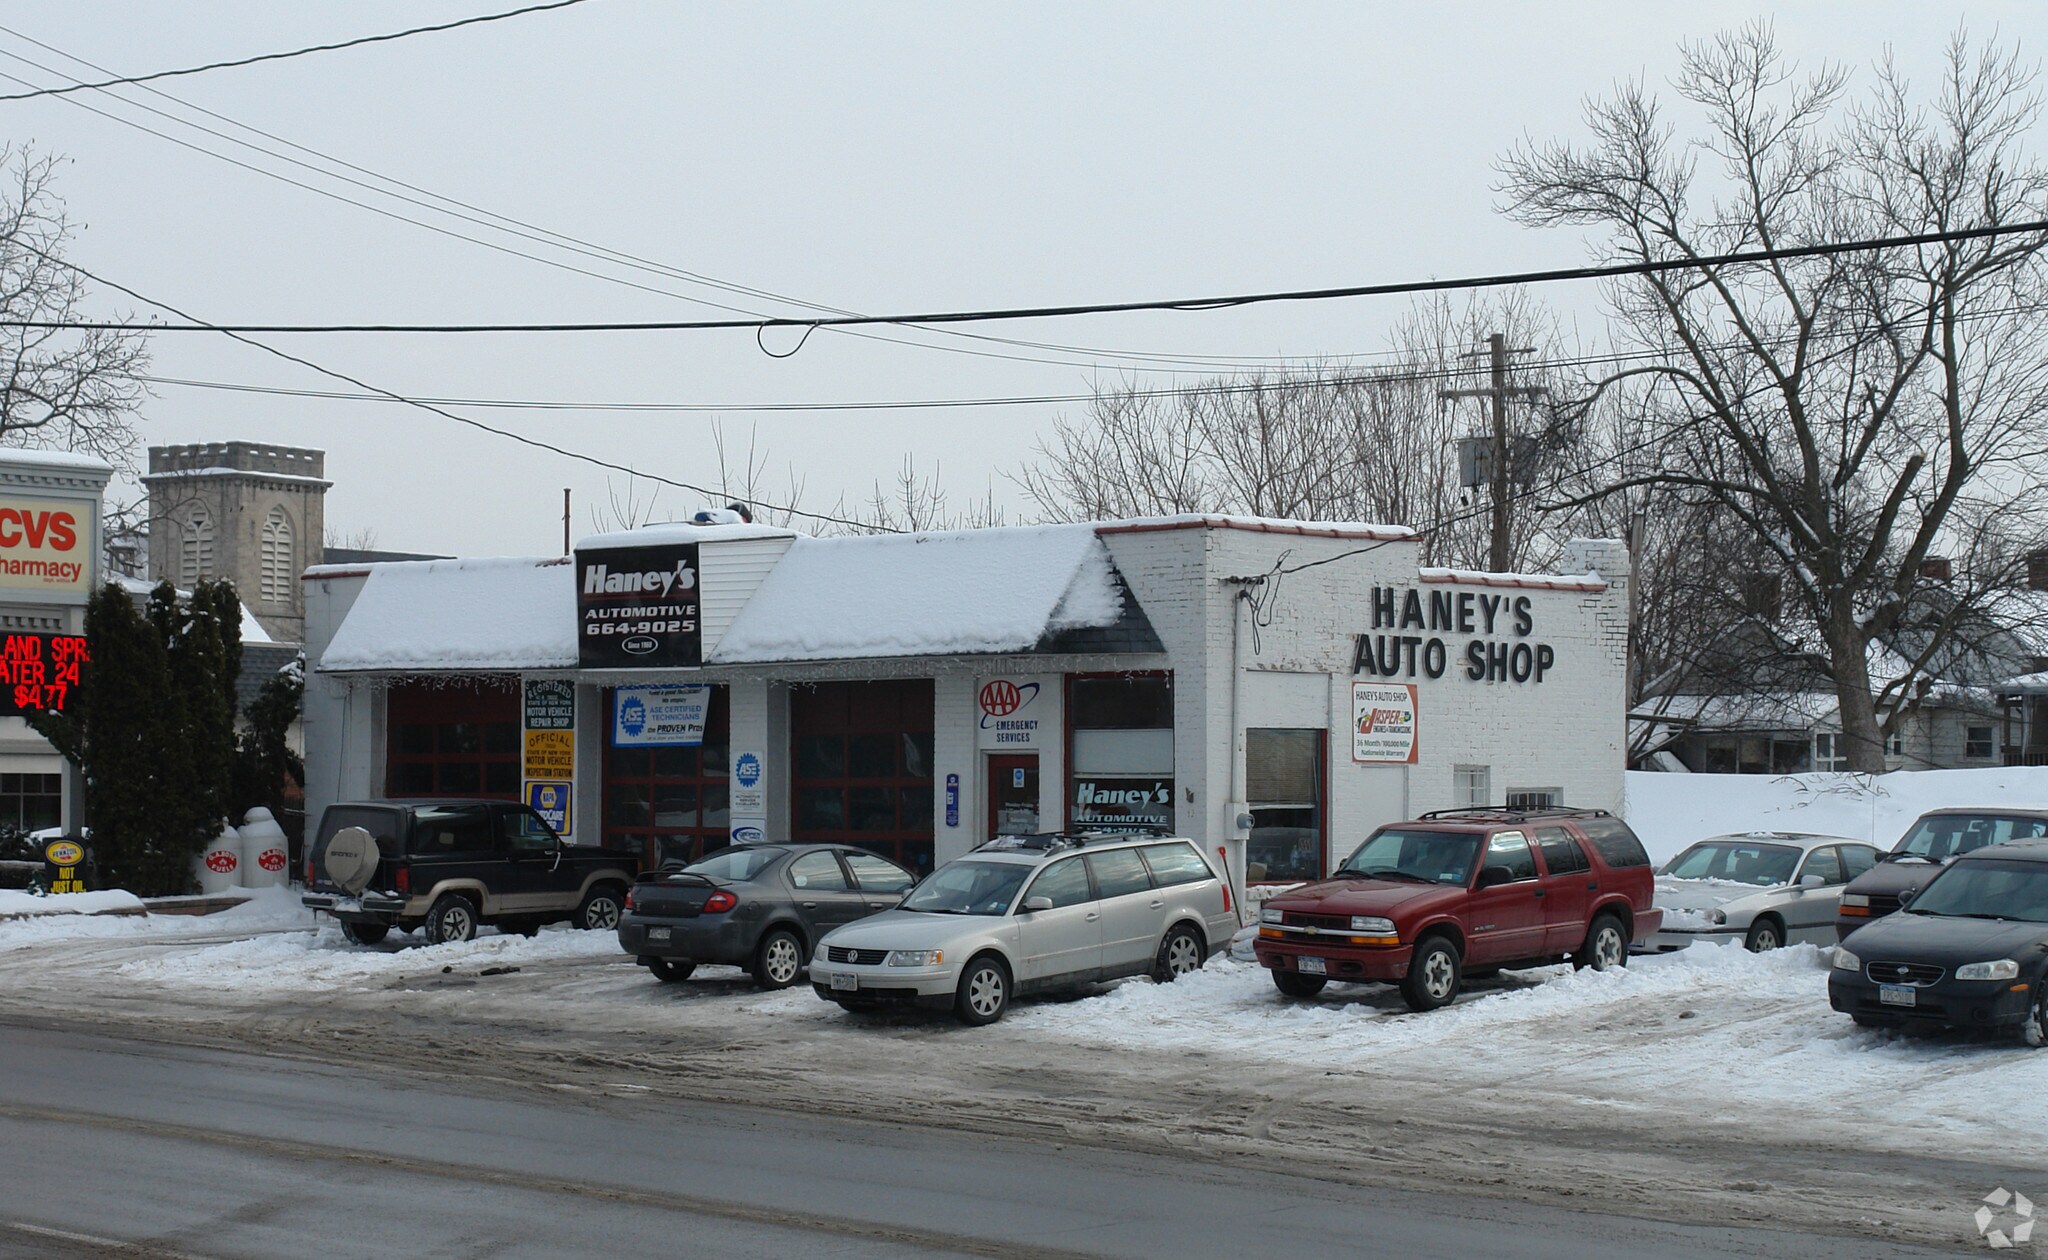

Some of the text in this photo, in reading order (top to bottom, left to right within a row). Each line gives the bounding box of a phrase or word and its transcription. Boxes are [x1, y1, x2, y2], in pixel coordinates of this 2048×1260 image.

[0, 508, 76, 551] CVS
[584, 559, 695, 598] Haney's
[585, 605, 696, 619] AUTOMOTIVE
[1372, 586, 1533, 637] HANEY'S
[0, 635, 41, 661] AND
[1353, 633, 1554, 683] AUTO SHOP
[55, 661, 79, 686] 24
[527, 680, 572, 700] REGISTERED
[1356, 691, 1407, 702] HANEY'S AUTO SHOP
[14, 684, 67, 710] $4.77
[983, 681, 1020, 715] AAA
[527, 706, 572, 717] MOTOR VEHICLE
[623, 706, 643, 721] ASE
[665, 705, 702, 713] CERTIFIED
[530, 717, 569, 727] REPAIR SHOP
[652, 713, 700, 721] TECHNICIANS
[1360, 708, 1401, 734] JASPER
[657, 724, 686, 733] PROVEN
[996, 720, 1039, 731] EMERGENCY
[529, 733, 570, 748] OFFICIAL
[996, 732, 1030, 743] SERVICES
[526, 756, 572, 766] MOTOR VEHICLE
[526, 768, 572, 777] INSPECTION STATION
[740, 763, 757, 775] ASE
[1077, 782, 1170, 809] Haney's
[1075, 814, 1168, 823] AUTOMOTIVE
[59, 866, 75, 879] NOT
[211, 863, 235, 873] FUELS
[50, 880, 70, 893] JUST
